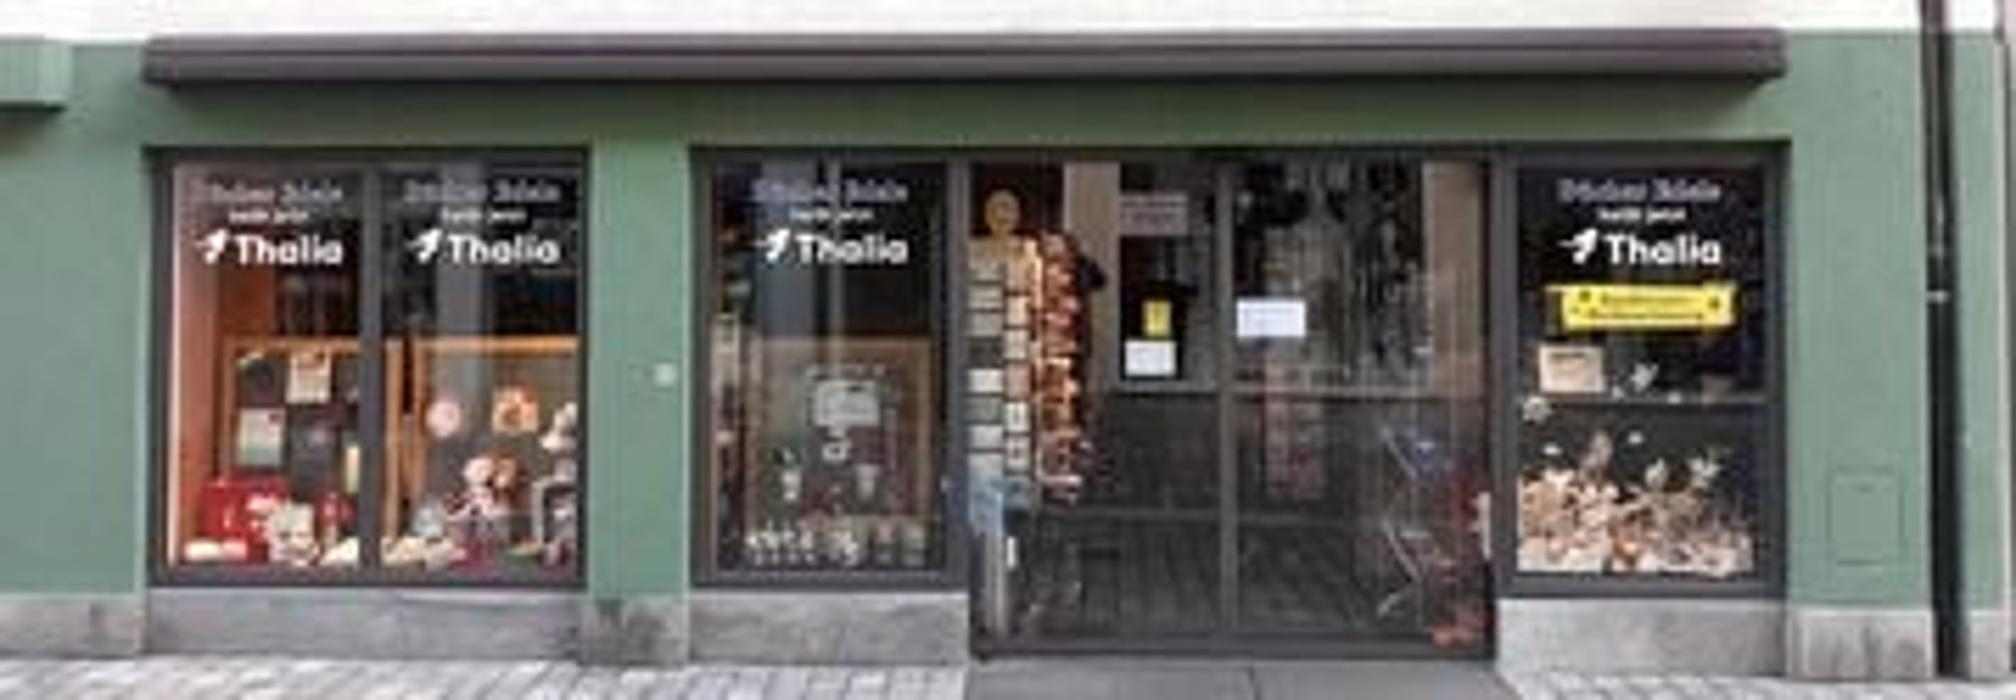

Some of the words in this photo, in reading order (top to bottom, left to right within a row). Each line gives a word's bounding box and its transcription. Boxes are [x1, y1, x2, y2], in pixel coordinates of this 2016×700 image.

[234, 234, 343, 265] Thalia
[447, 233, 560, 265] Thalia
[795, 232, 908, 264] Thalia
[1604, 233, 1721, 265] Thalia
